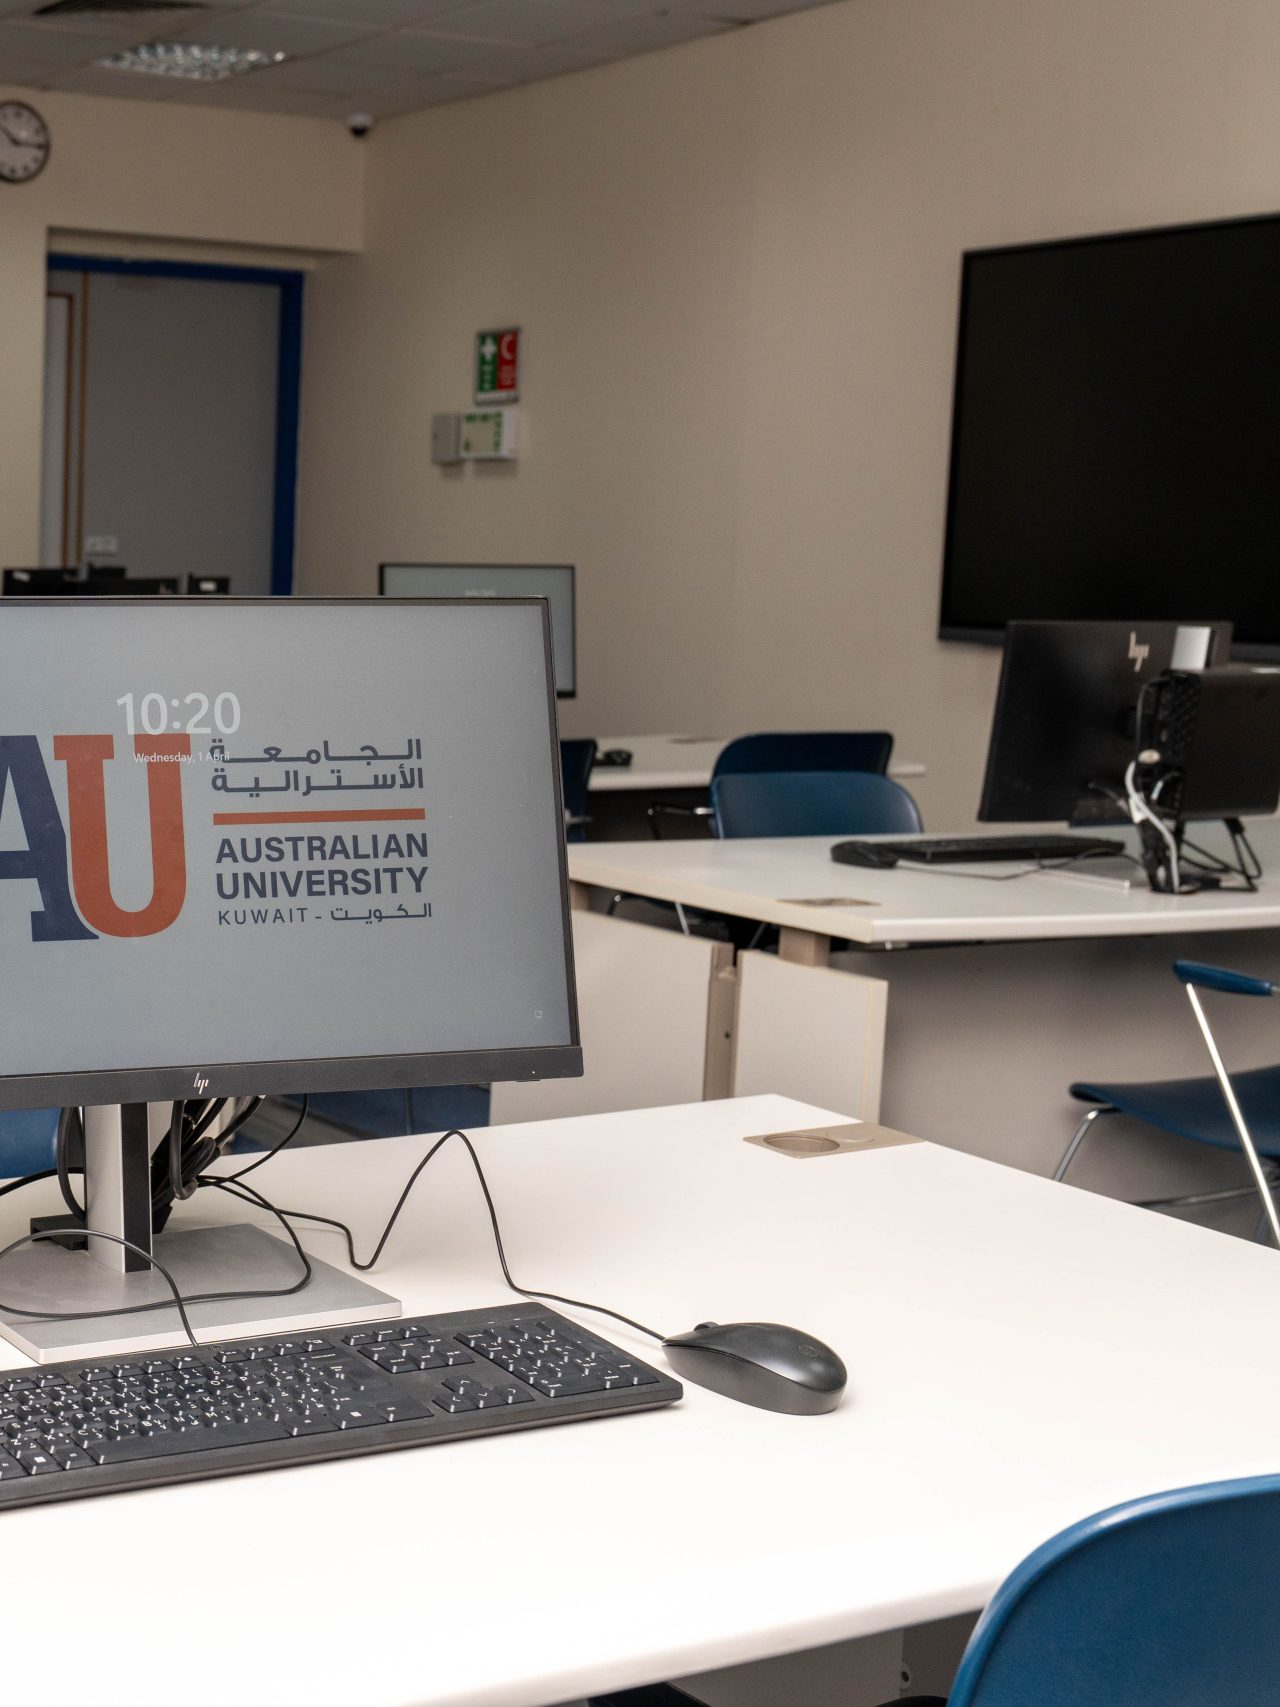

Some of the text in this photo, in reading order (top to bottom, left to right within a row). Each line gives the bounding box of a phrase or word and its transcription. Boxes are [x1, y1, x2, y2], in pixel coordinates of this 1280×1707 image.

[116, 691, 241, 735] 10:20
[133, 752, 196, 765] Wednesday,
[205, 751, 230, 763] April
[210, 738, 422, 766] الجامعة
[211, 765, 424, 798] الأسترالية
[216, 832, 429, 864] AUSTRALIAN
[216, 866, 429, 900] UNIVERSITY
[219, 907, 309, 926] KUWAIT
[330, 902, 432, 924] الكويت
